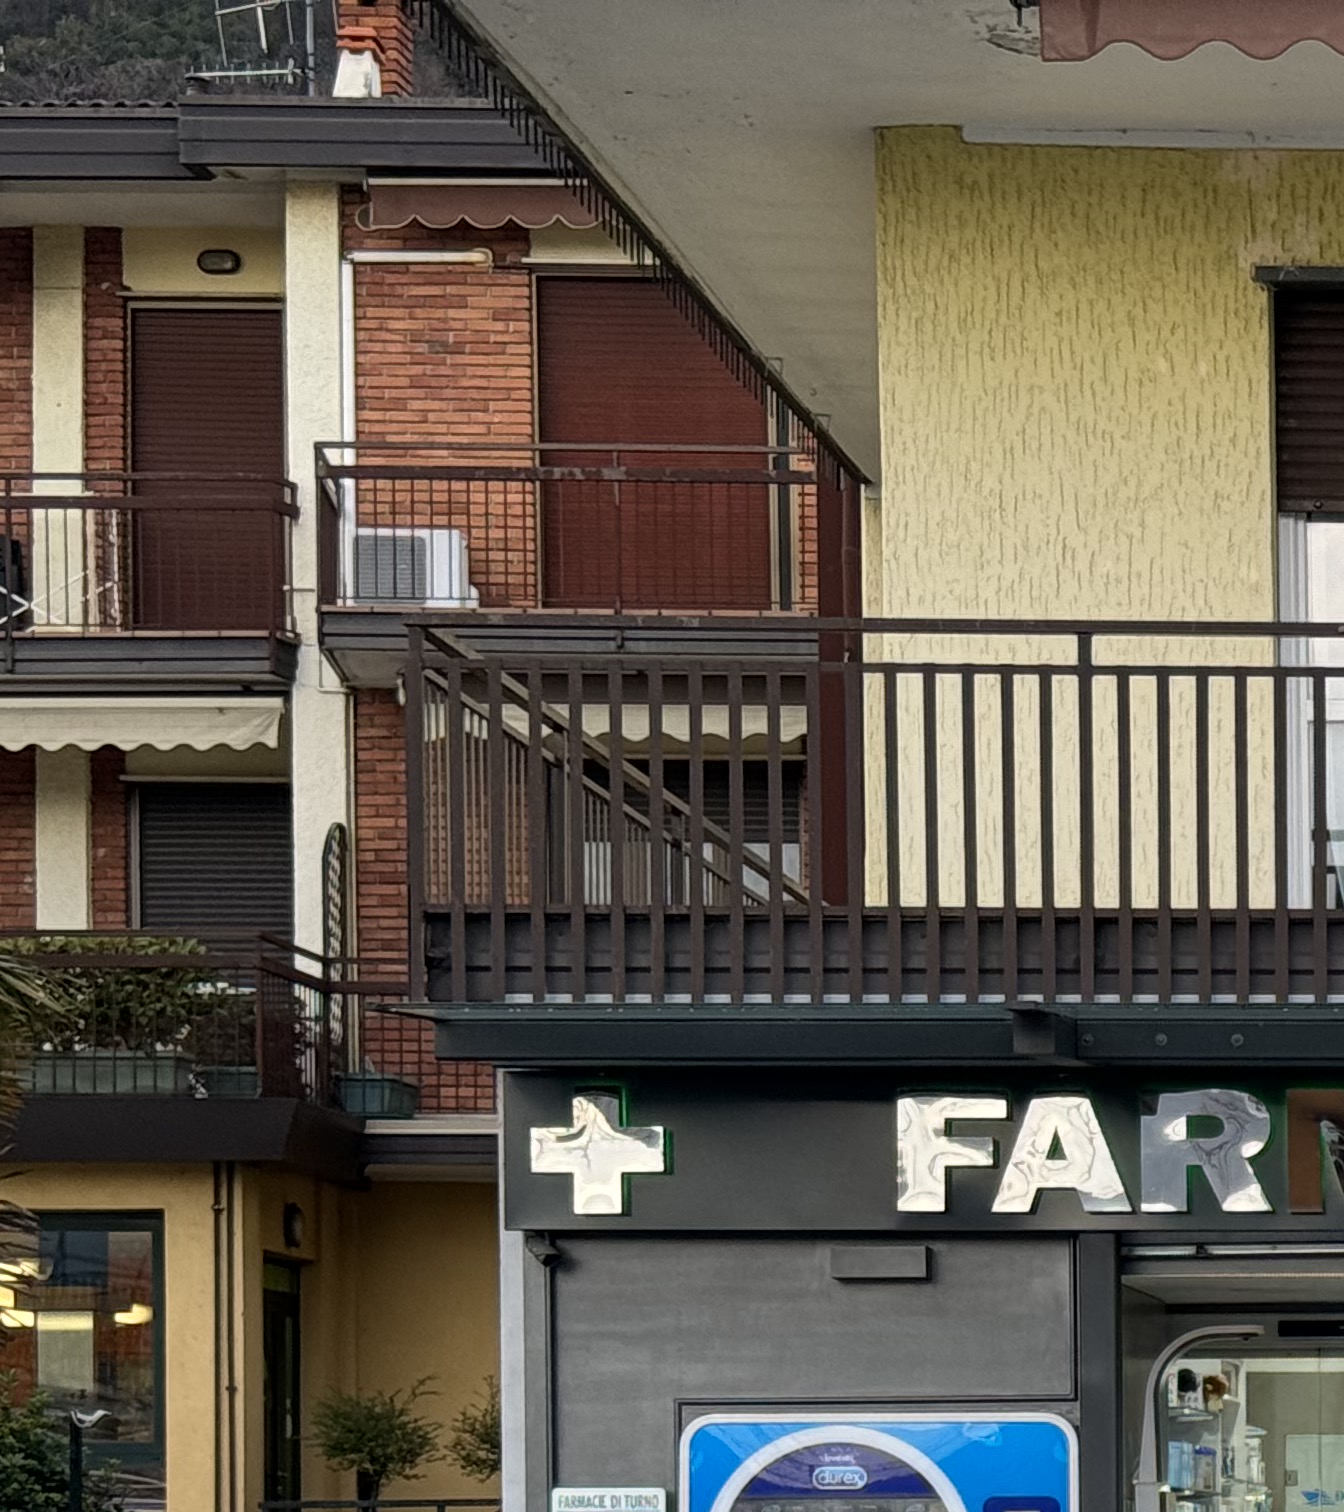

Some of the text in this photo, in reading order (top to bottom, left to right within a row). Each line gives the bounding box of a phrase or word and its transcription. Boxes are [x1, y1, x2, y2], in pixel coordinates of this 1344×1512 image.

[818, 1470, 860, 1485] durex
[557, 1494, 660, 1509] FARMACIE DI TURNO
